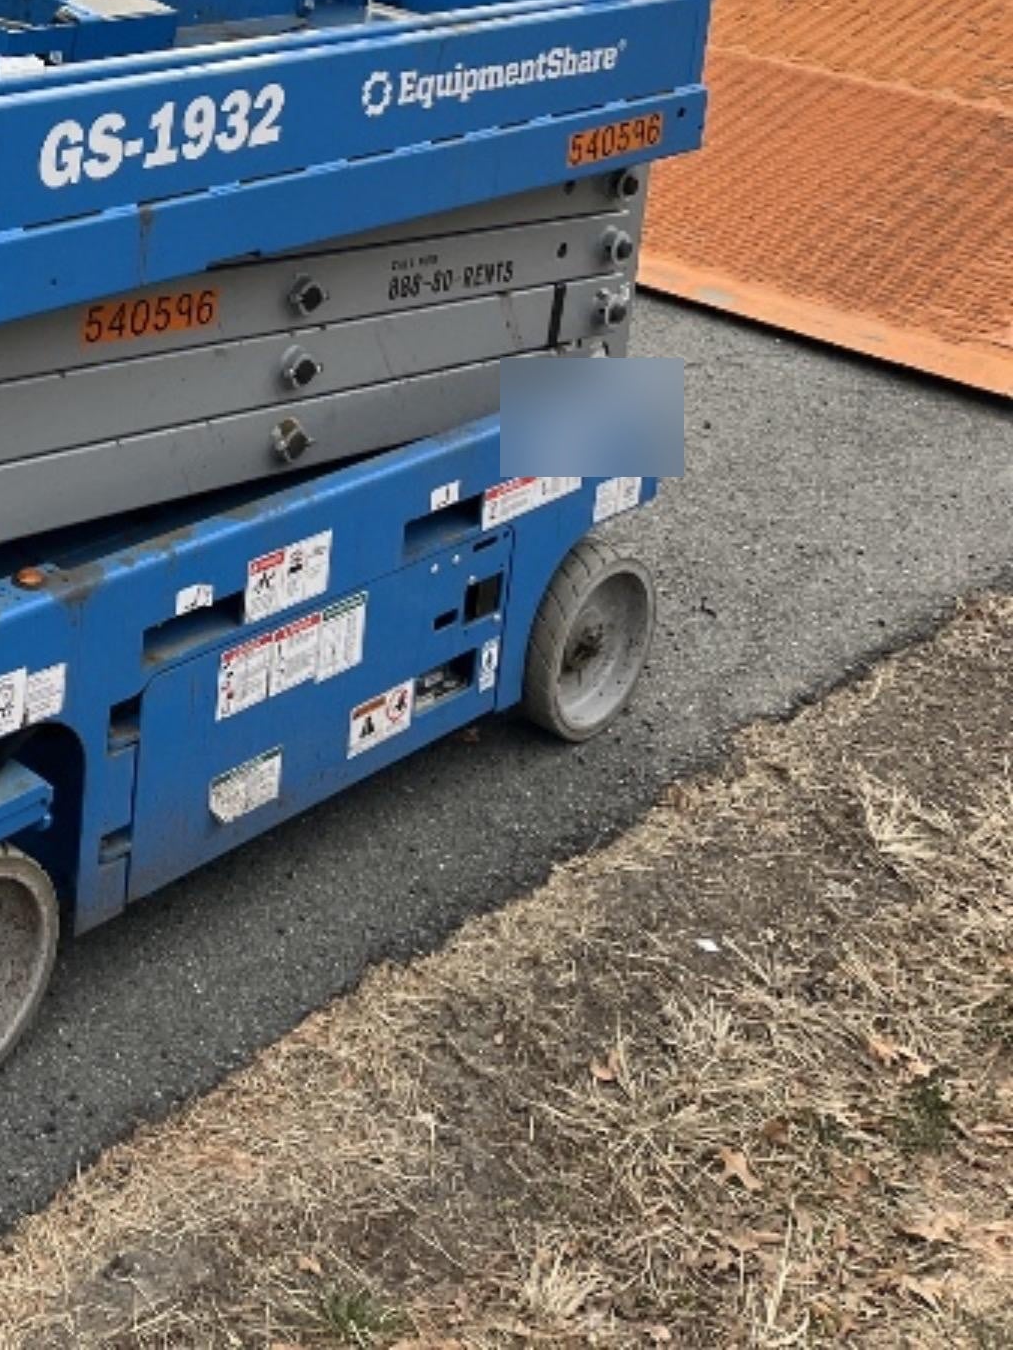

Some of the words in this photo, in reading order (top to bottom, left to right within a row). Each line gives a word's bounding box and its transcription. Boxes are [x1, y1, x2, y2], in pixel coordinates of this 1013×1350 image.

[39, 83, 286, 190] GS-1932
[570, 114, 660, 165] 540596
[85, 290, 216, 343] 540596
